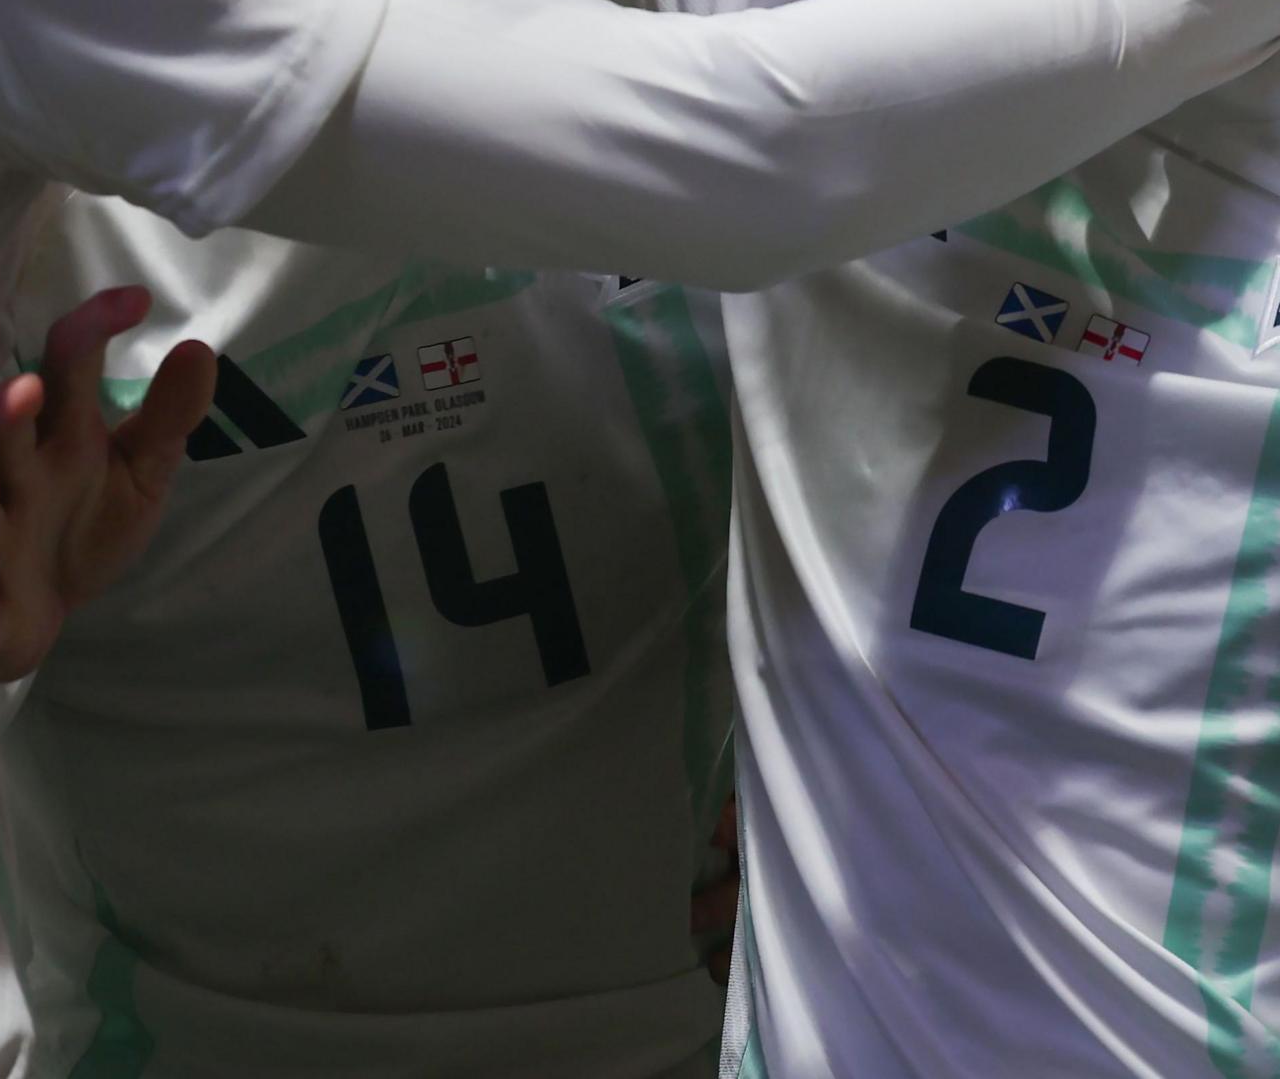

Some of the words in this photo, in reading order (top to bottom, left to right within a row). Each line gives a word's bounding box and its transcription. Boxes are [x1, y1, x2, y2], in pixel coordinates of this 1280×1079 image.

[344, 408, 399, 432] HAMPDEN
[435, 414, 463, 432] 2024
[910, 355, 1097, 660] 2
[318, 461, 591, 731] 14
